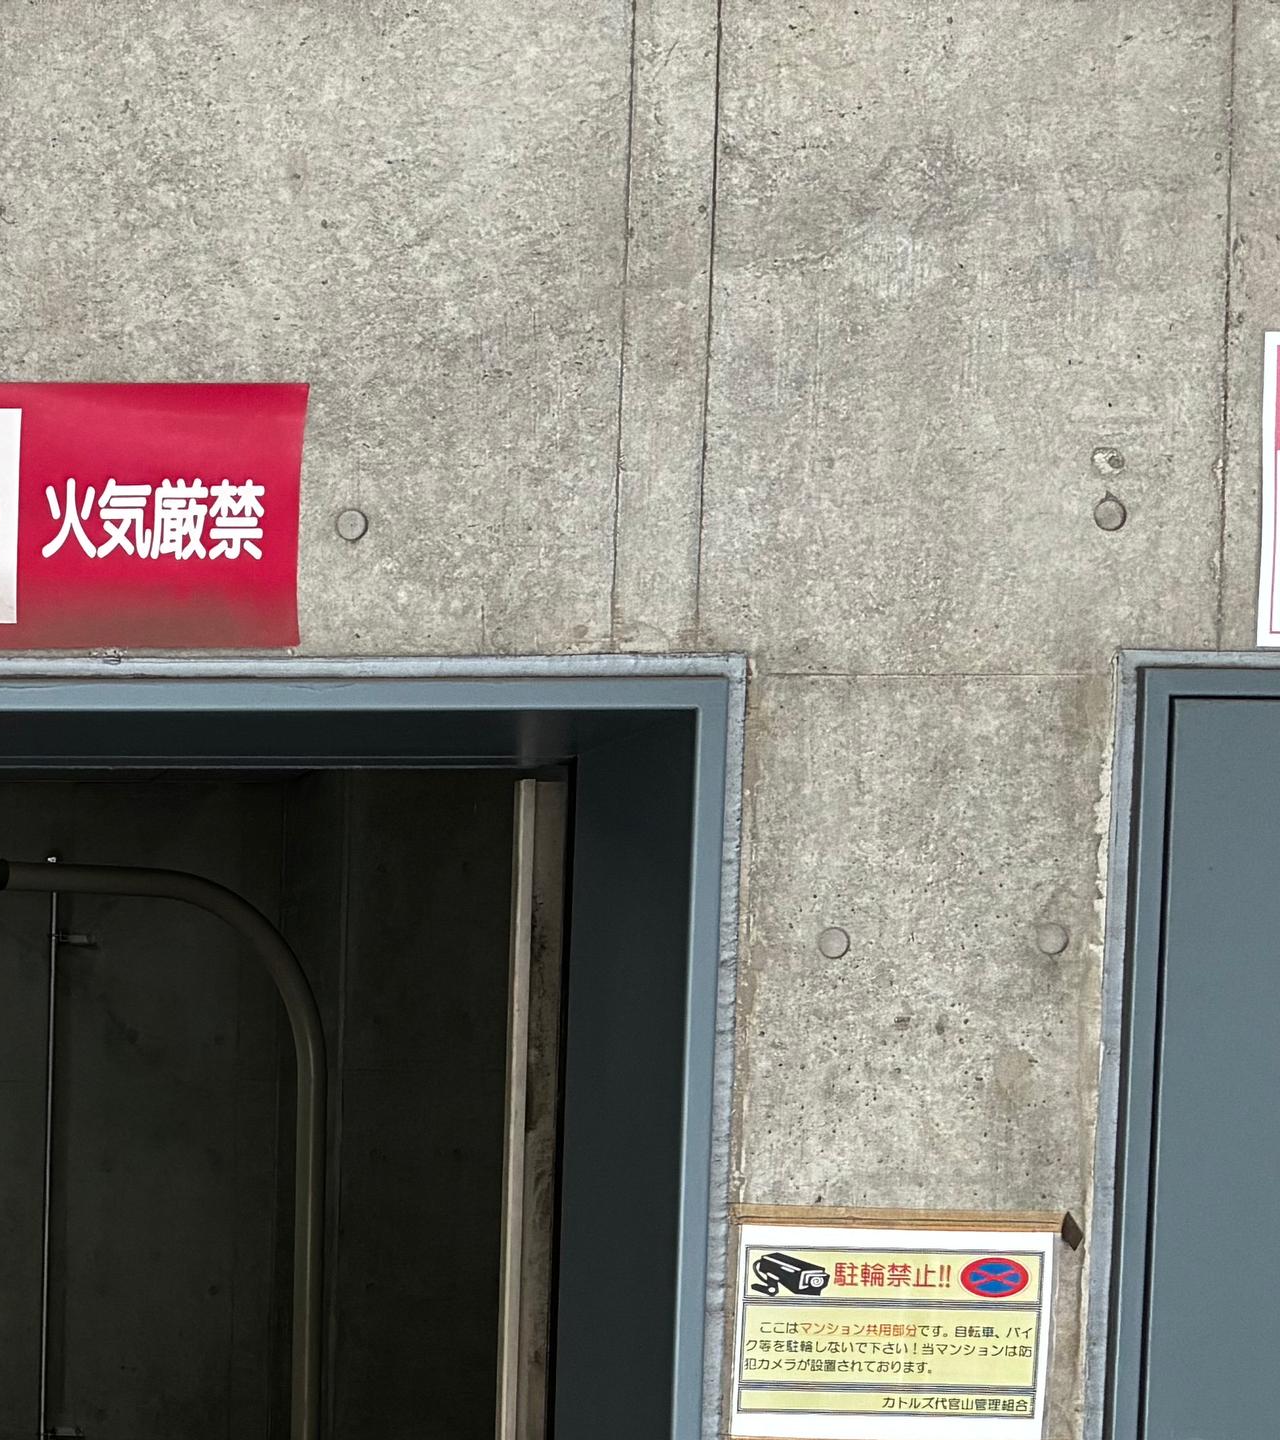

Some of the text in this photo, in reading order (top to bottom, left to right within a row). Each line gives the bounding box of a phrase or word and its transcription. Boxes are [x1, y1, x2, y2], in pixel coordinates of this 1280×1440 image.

[41, 478, 265, 560] 火気厳禁
[834, 1262, 952, 1288] 駐輪禁止!!
[759, 1321, 1033, 1339] ここはマンション共用部分です。自転車、バイ
[744, 1358, 933, 1374] 犯カメラが設置されております。
[882, 1396, 1028, 1412] カトルズ代官山管理組合
